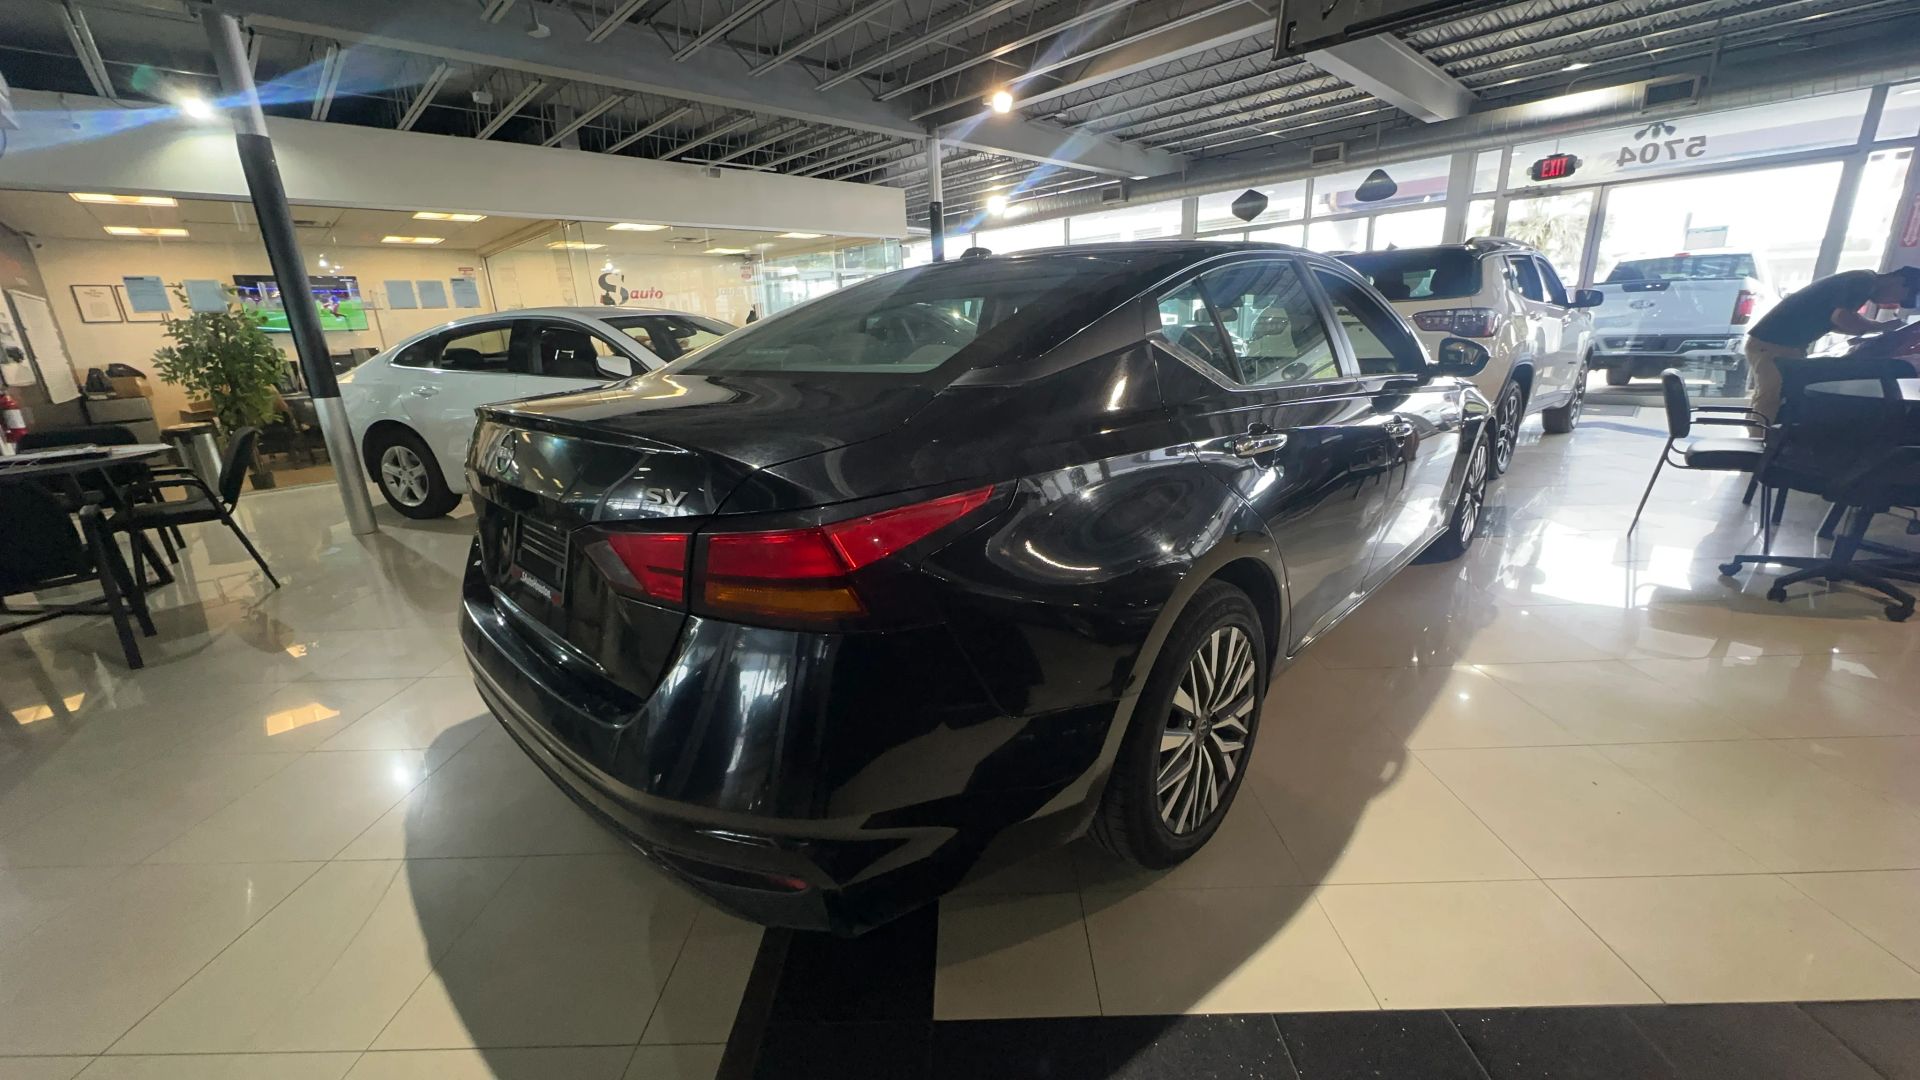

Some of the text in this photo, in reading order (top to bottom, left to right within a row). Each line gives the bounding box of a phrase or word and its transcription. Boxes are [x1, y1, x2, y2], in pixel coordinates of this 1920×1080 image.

[1541, 157, 1569, 178] EXIT
[630, 287, 664, 300] auto
[646, 487, 689, 506] SV
